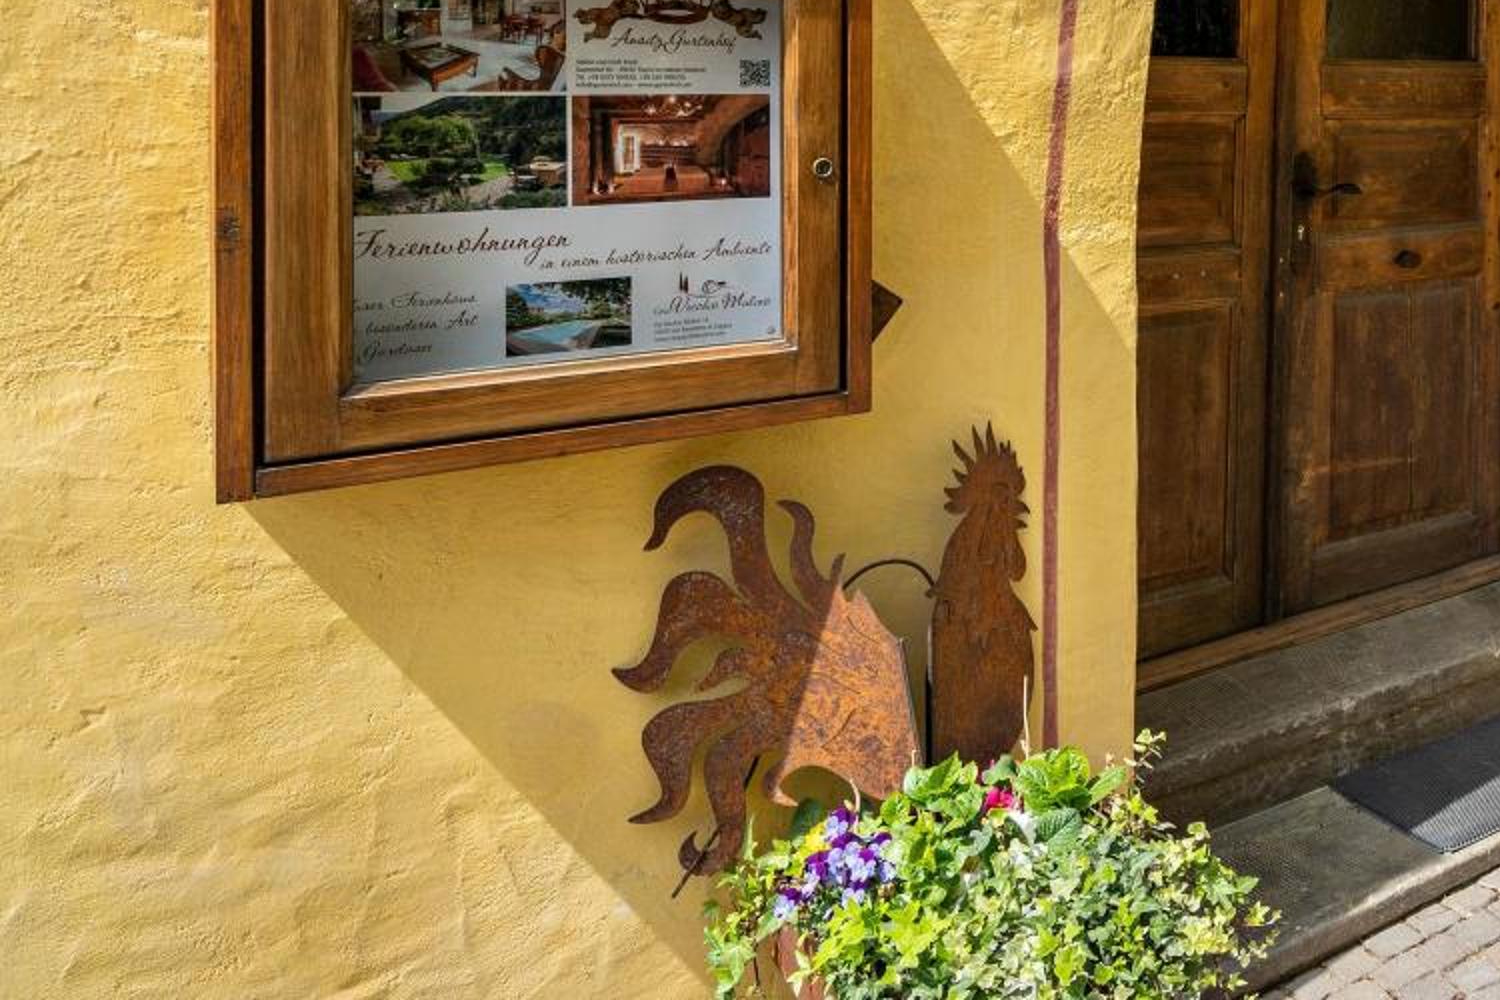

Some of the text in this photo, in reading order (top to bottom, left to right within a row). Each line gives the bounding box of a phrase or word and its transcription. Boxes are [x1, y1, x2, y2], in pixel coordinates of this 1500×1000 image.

[355, 227, 571, 265] Ferienwohnungen
[605, 245, 697, 266] historischen
[702, 237, 773, 261] Ambiente
